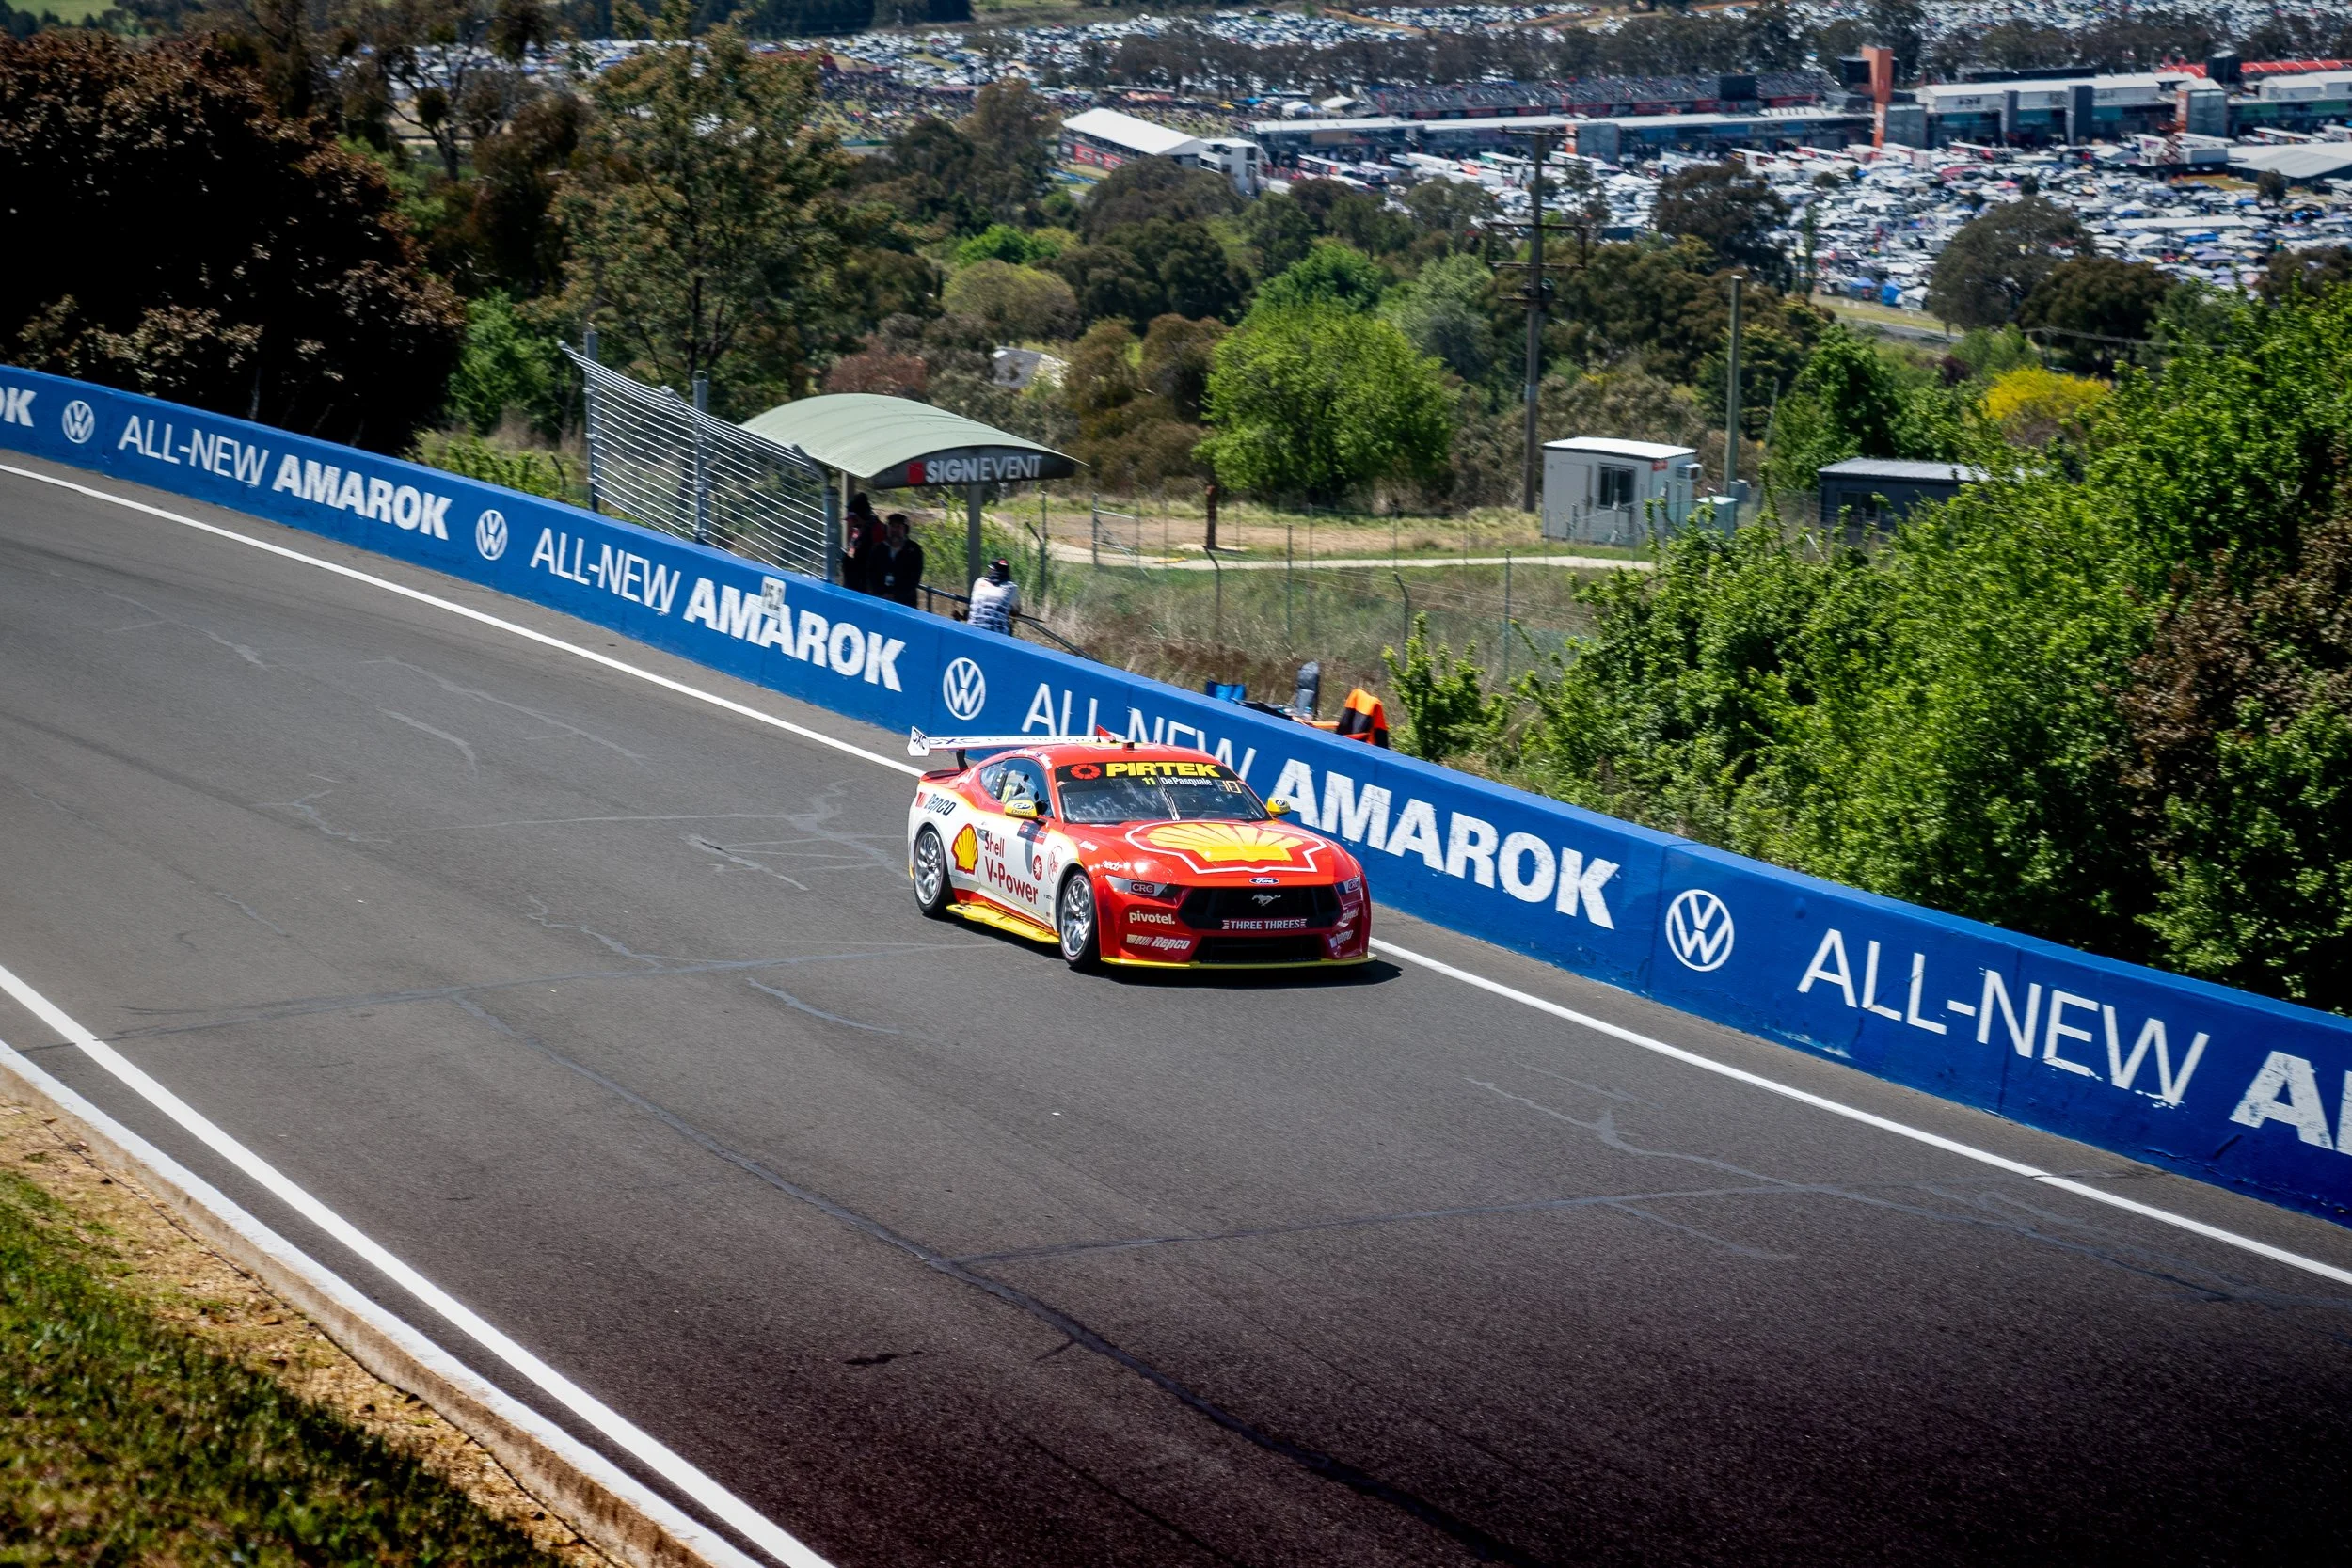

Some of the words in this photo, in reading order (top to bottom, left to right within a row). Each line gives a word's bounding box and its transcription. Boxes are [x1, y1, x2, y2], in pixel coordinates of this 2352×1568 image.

[0, 387, 37, 428] K
[118, 415, 270, 487] ALL-NEW
[271, 453, 453, 541] AMAROK
[530, 527, 680, 616] ALL-NEW
[683, 577, 906, 692] AMAROK
[1105, 762, 1221, 778] PIRTEK
[1142, 777, 1156, 785] 11
[984, 832, 1005, 858] Shell
[1271, 758, 1620, 930] AMAROK
[984, 856, 1038, 904] V-Power
[1132, 883, 1154, 893] CRC
[1231, 920, 1262, 929] THREE
[1264, 919, 1300, 929] THREES
[1152, 936, 1191, 950] Repco
[1797, 928, 2210, 1108] ALL-NEW
[2229, 1050, 2352, 1157] A
